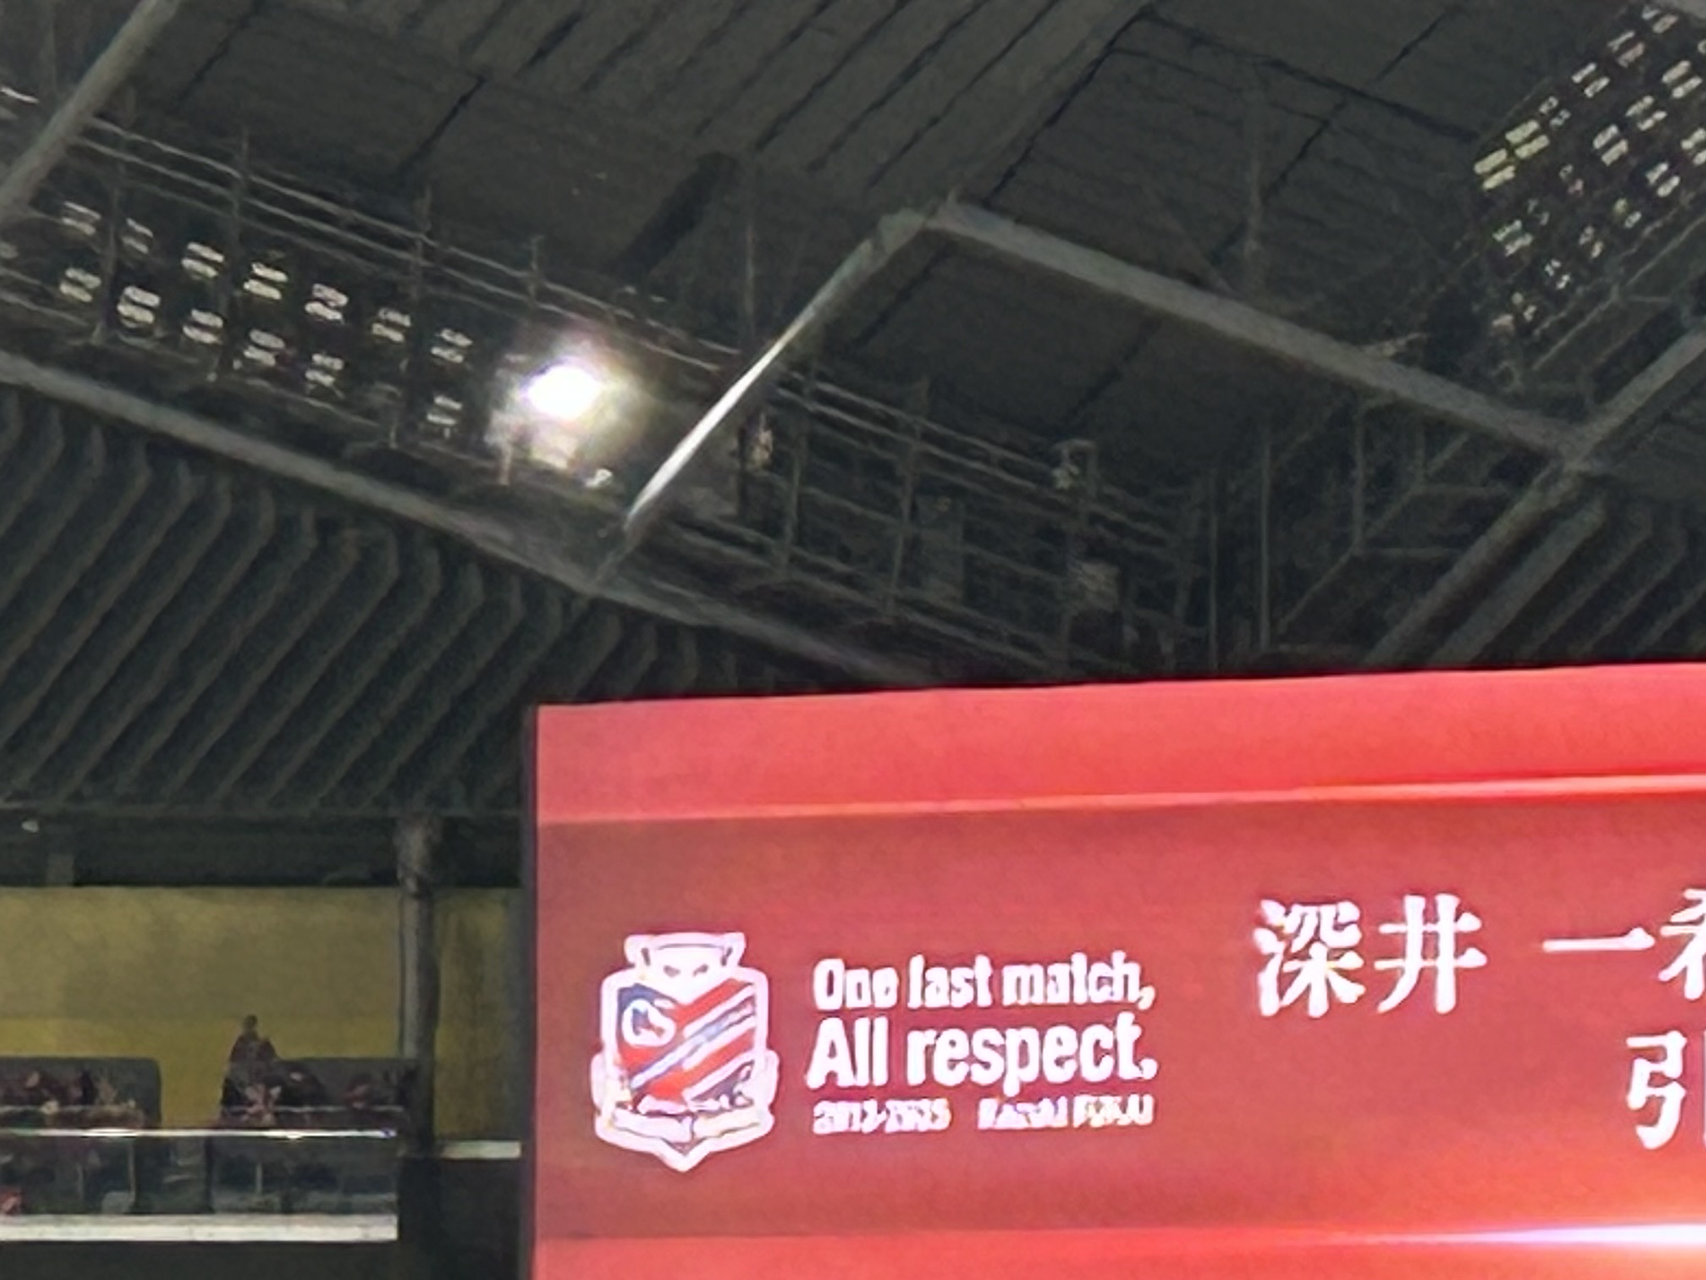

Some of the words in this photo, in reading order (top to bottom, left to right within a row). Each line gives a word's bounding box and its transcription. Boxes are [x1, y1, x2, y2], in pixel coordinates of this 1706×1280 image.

[812, 957, 900, 1010] One
[906, 954, 993, 1009] last
[1001, 950, 1156, 1010] match,
[1252, 892, 1488, 1018] 深井
[805, 1016, 889, 1089] All
[905, 1011, 1158, 1097] respect.
